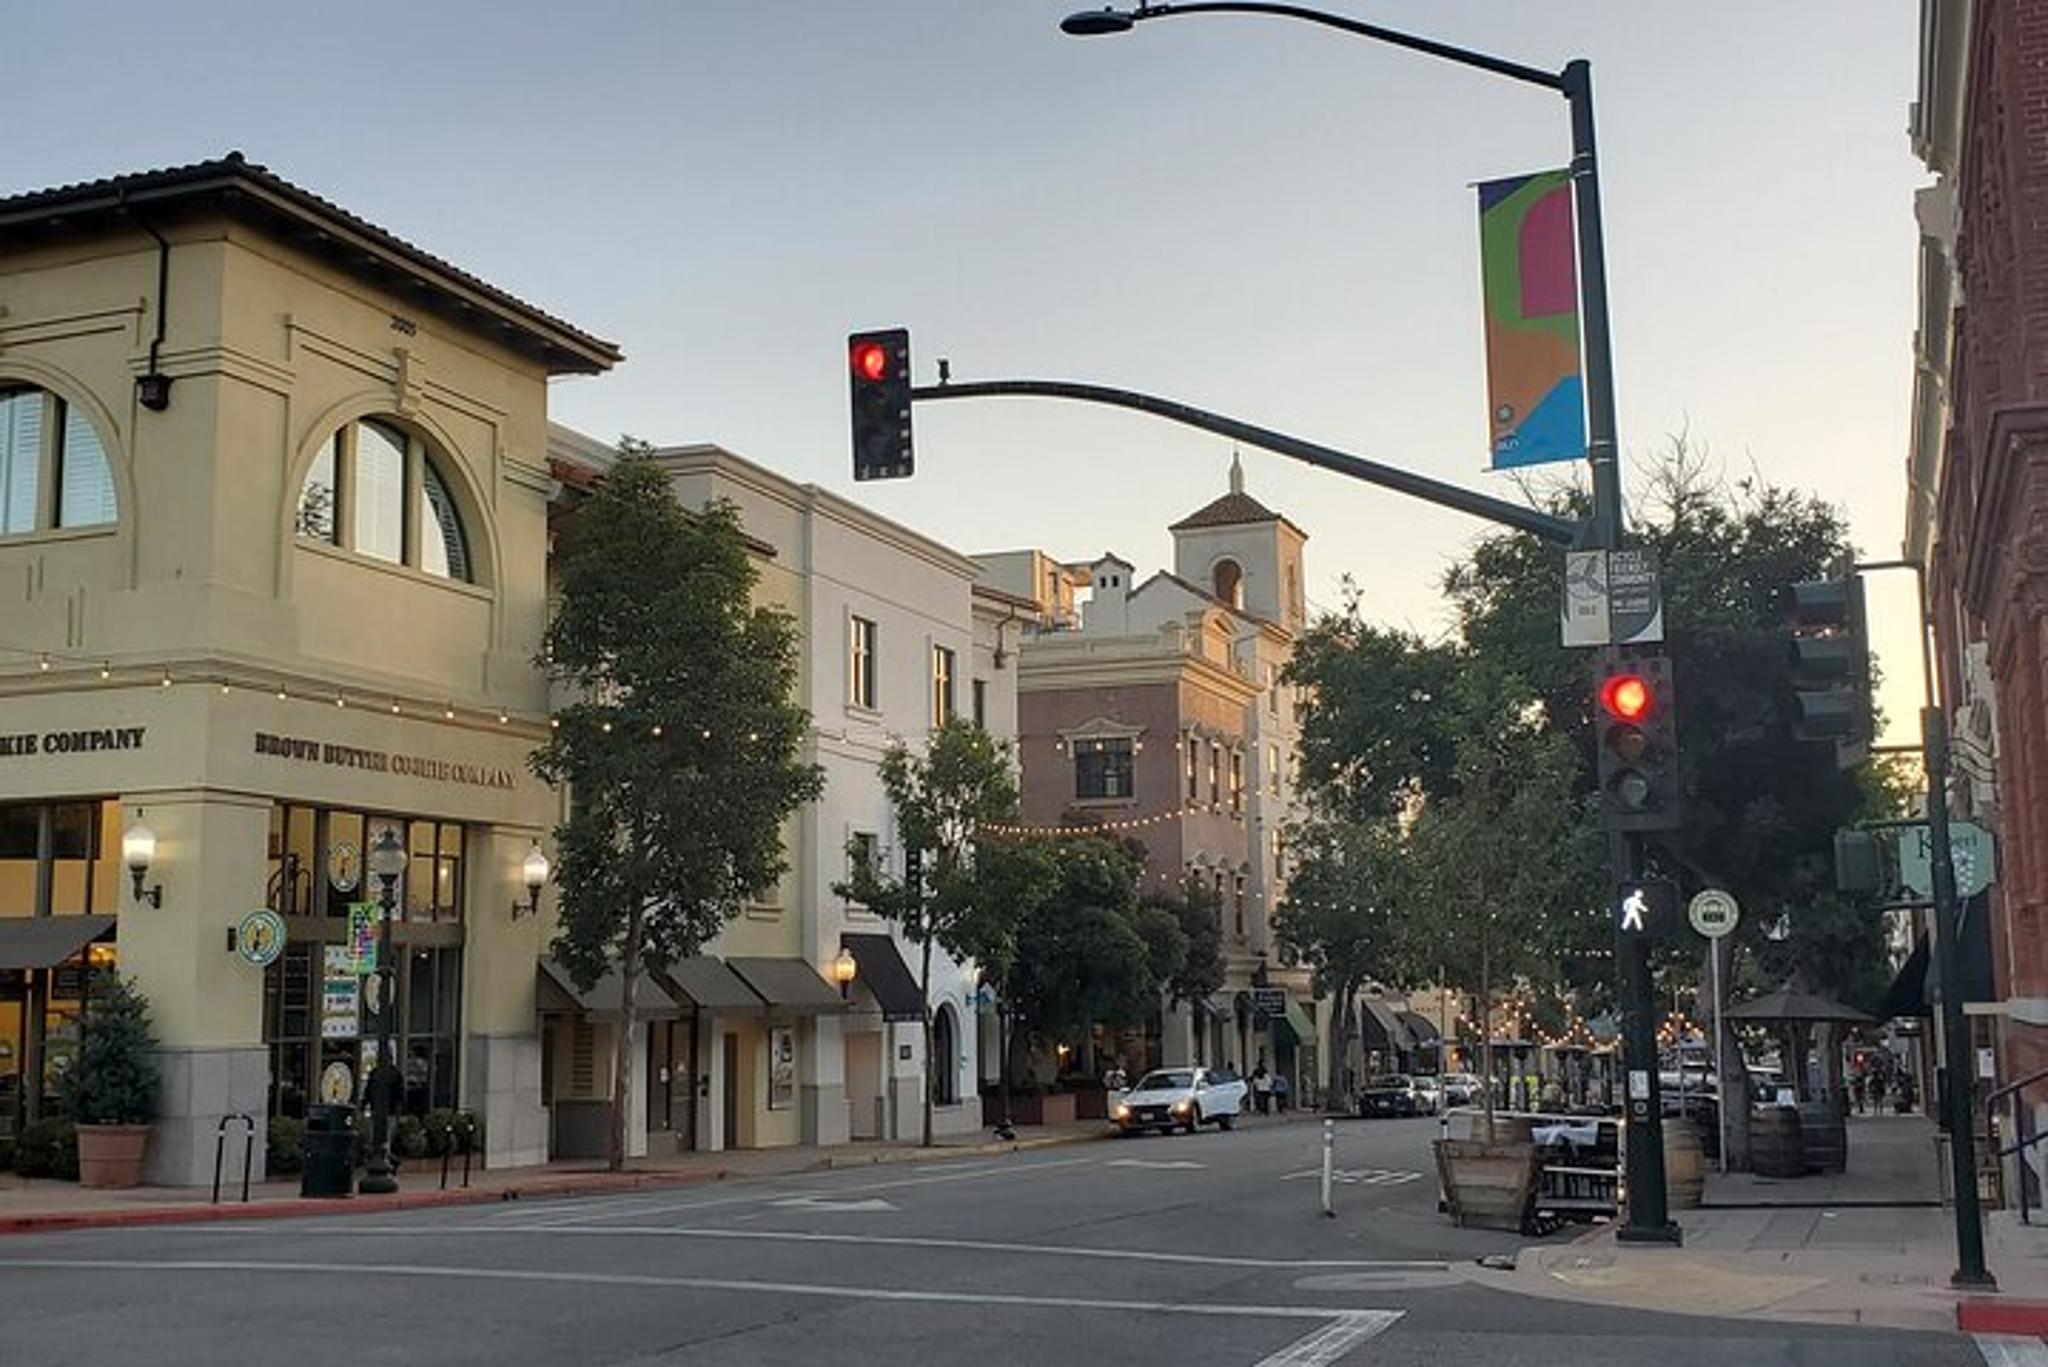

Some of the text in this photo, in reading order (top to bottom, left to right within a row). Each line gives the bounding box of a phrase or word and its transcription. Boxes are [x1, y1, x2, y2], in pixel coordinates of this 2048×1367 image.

[42, 725, 146, 754] COMPANY
[255, 732, 320, 762] BROWN
[323, 743, 389, 772] BUTTER
